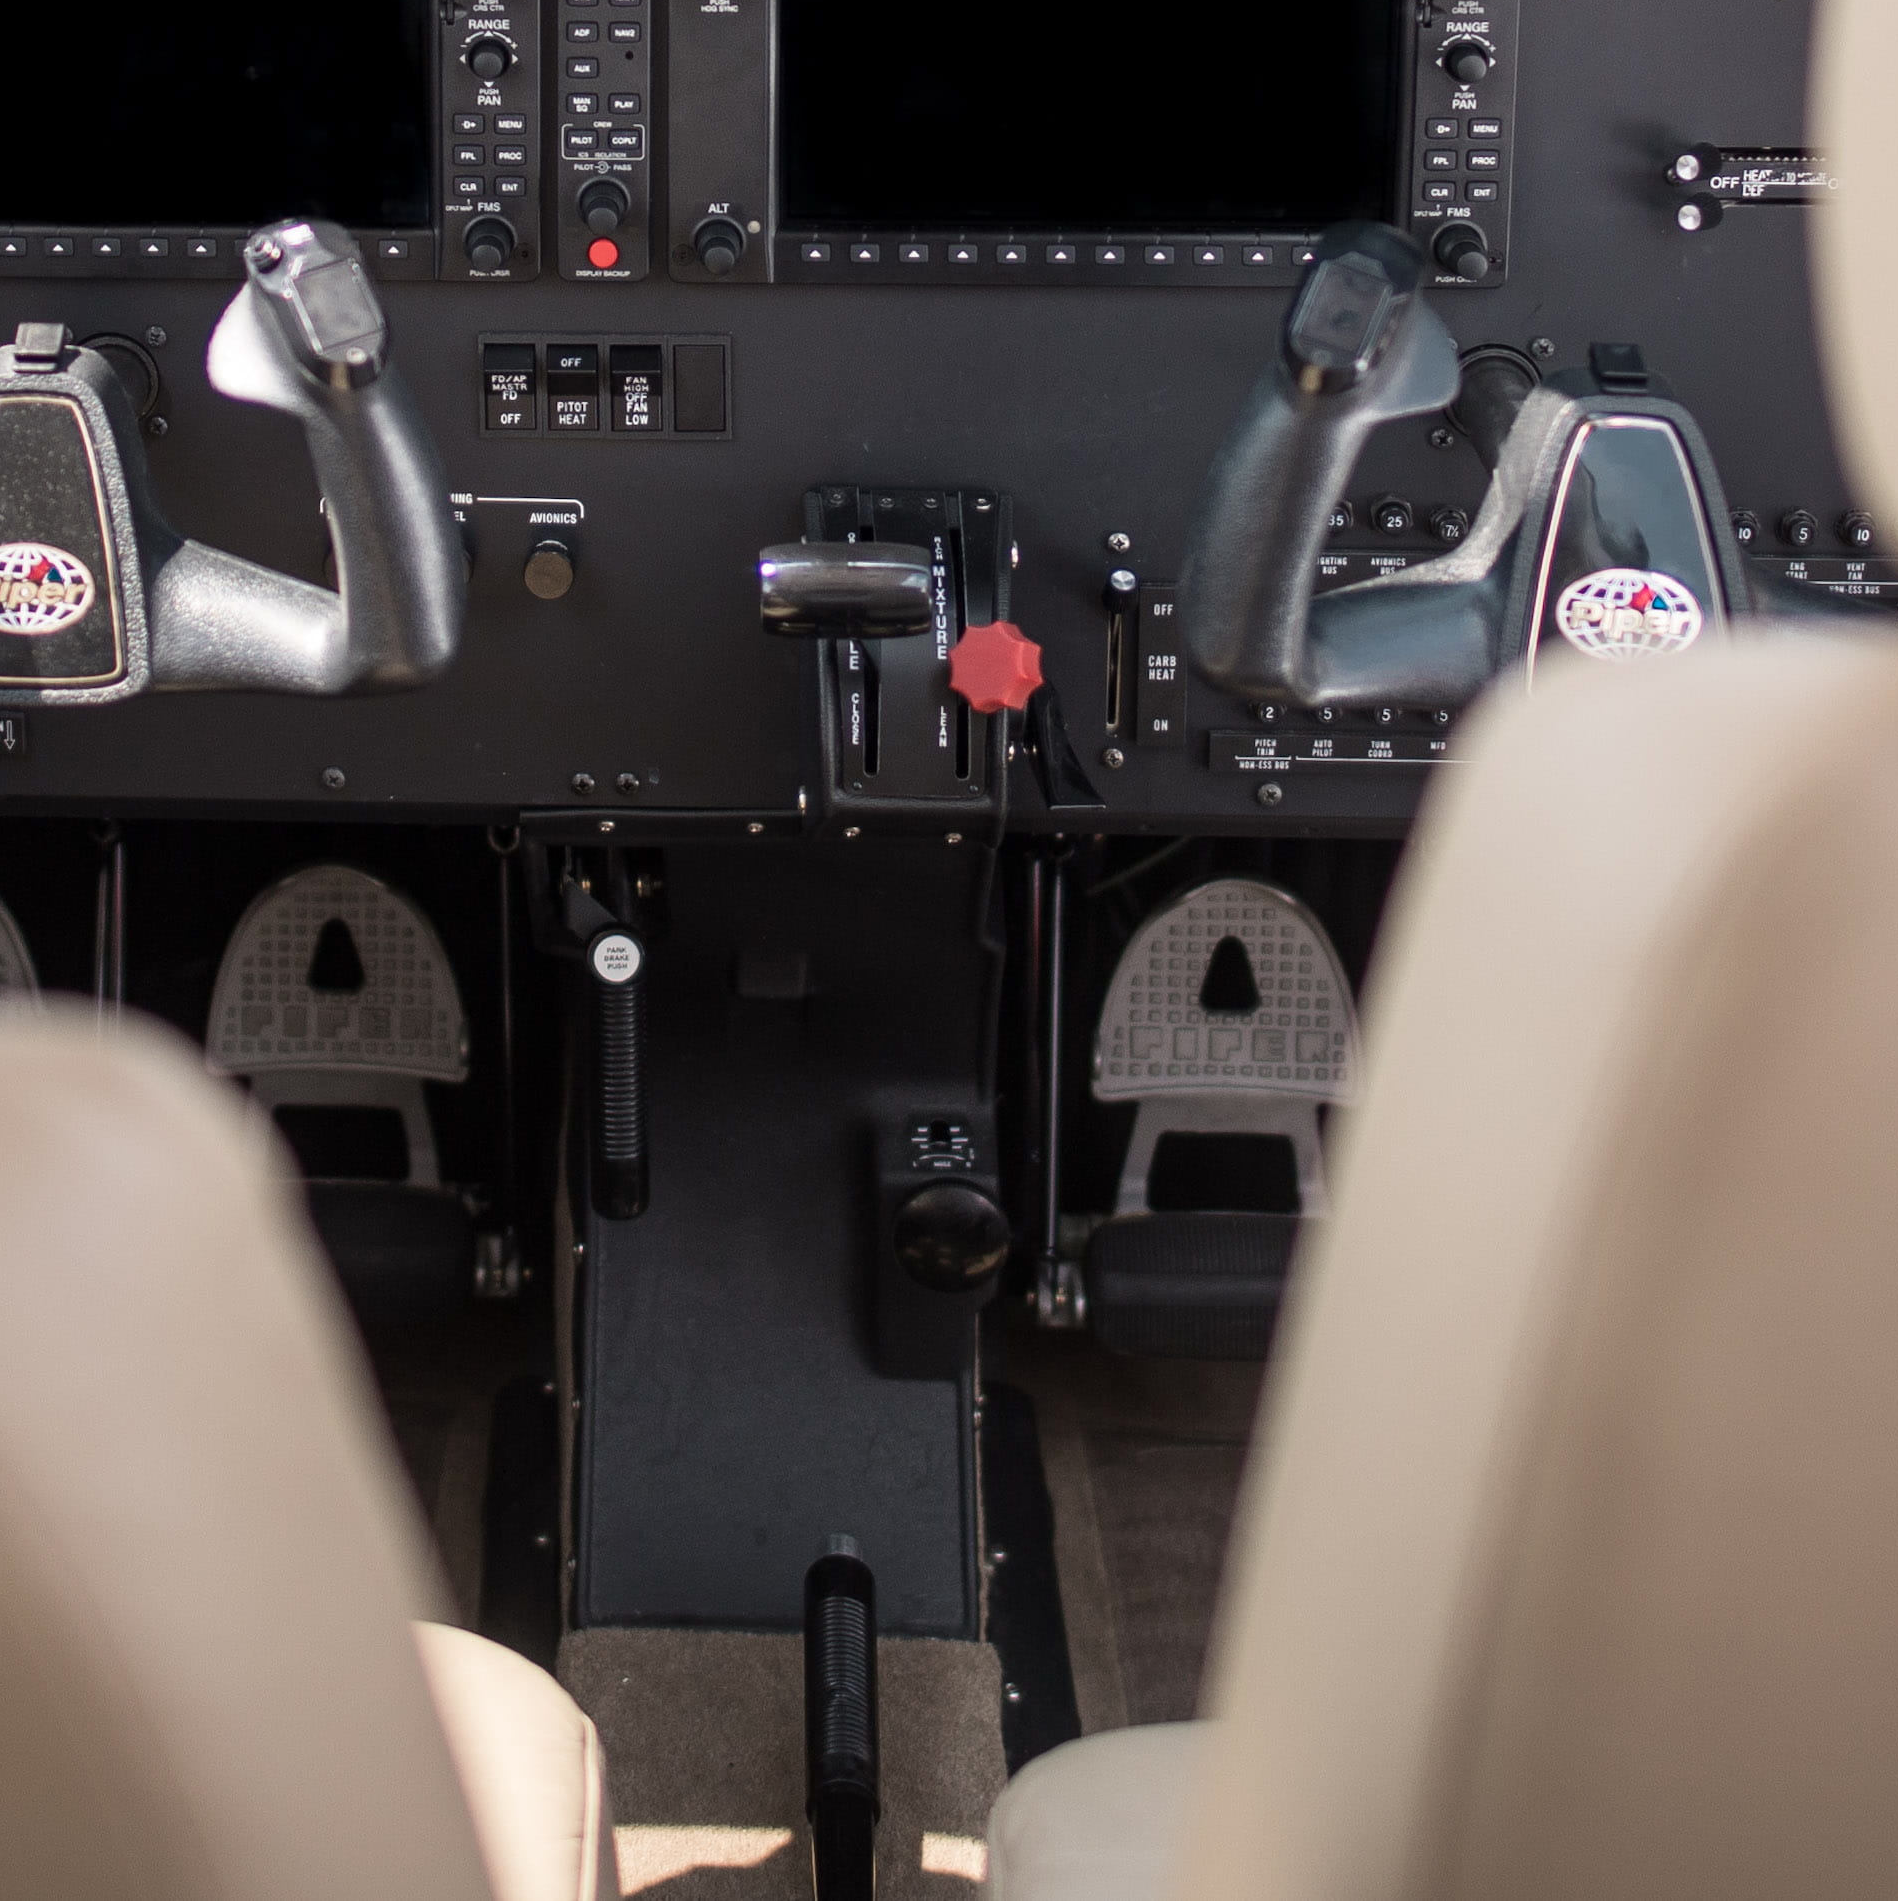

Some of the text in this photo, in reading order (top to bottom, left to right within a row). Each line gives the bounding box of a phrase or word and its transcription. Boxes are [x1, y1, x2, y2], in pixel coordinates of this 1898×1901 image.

[468, 19, 510, 30] RANGE
[1446, 22, 1490, 33] RANGE
[574, 29, 590, 37] ADF
[574, 64, 590, 73] AUX
[477, 95, 501, 106] PAN
[614, 100, 634, 109] PLAY
[1452, 99, 1477, 110] PAN
[498, 120, 523, 129] MENU
[1473, 125, 1498, 134] MENU
[460, 152, 476, 161] FPL
[499, 152, 522, 161] PROC
[1433, 156, 1449, 165] FPL
[1472, 157, 1496, 165] PROC
[460, 183, 477, 192] CLR
[502, 183, 518, 192] ENT
[1710, 176, 1740, 189] OFF
[1431, 188, 1448, 197] CLR
[1474, 188, 1491, 197] ENT
[1742, 185, 1765, 197] DEF
[477, 202, 501, 212] FMS
[708, 202, 730, 214] ALT
[1447, 207, 1471, 217] FMS
[560, 357, 582, 367] OFF
[491, 374, 527, 384] FD/AP
[625, 376, 647, 384] FAN
[492, 383, 528, 391] MASTR
[624, 384, 649, 392] HIGH
[502, 390, 518, 401] FD
[626, 392, 648, 402] OFF
[556, 402, 589, 413] PITOT
[626, 402, 648, 413] FAN
[500, 413, 522, 425] OFF
[559, 414, 587, 425] HEAT
[625, 414, 649, 425] LOW
[529, 512, 578, 524] AVIONICS
[1387, 515, 1402, 528] 25
[1738, 528, 1752, 540] 10
[1799, 527, 1808, 540] 5
[1857, 529, 1870, 541] 10
[933, 536, 943, 560] RICH
[1370, 557, 1406, 566] AVIONICS
[1322, 566, 1337, 575] BUS
[932, 565, 947, 660] MIXTURE
[1153, 604, 1173, 616] OFF
[1569, 599, 1692, 639] Piper
[1148, 655, 1177, 667] CARB
[1148, 669, 1176, 680] HEAT
[1265, 706, 1274, 719] 2
[1323, 707, 1332, 720] 5
[1381, 708, 1391, 721] 5
[1439, 709, 1448, 722] 5
[851, 693, 860, 745] CLOSE
[939, 705, 947, 747] LEAN
[1153, 719, 1168, 731] ON
[1254, 739, 1277, 748] PITCH
[1313, 739, 1333, 748] AUTO
[1371, 740, 1391, 749] TURN
[1256, 747, 1275, 756] TRIM
[1312, 748, 1333, 757] PILOT
[1274, 761, 1290, 770] BUS
